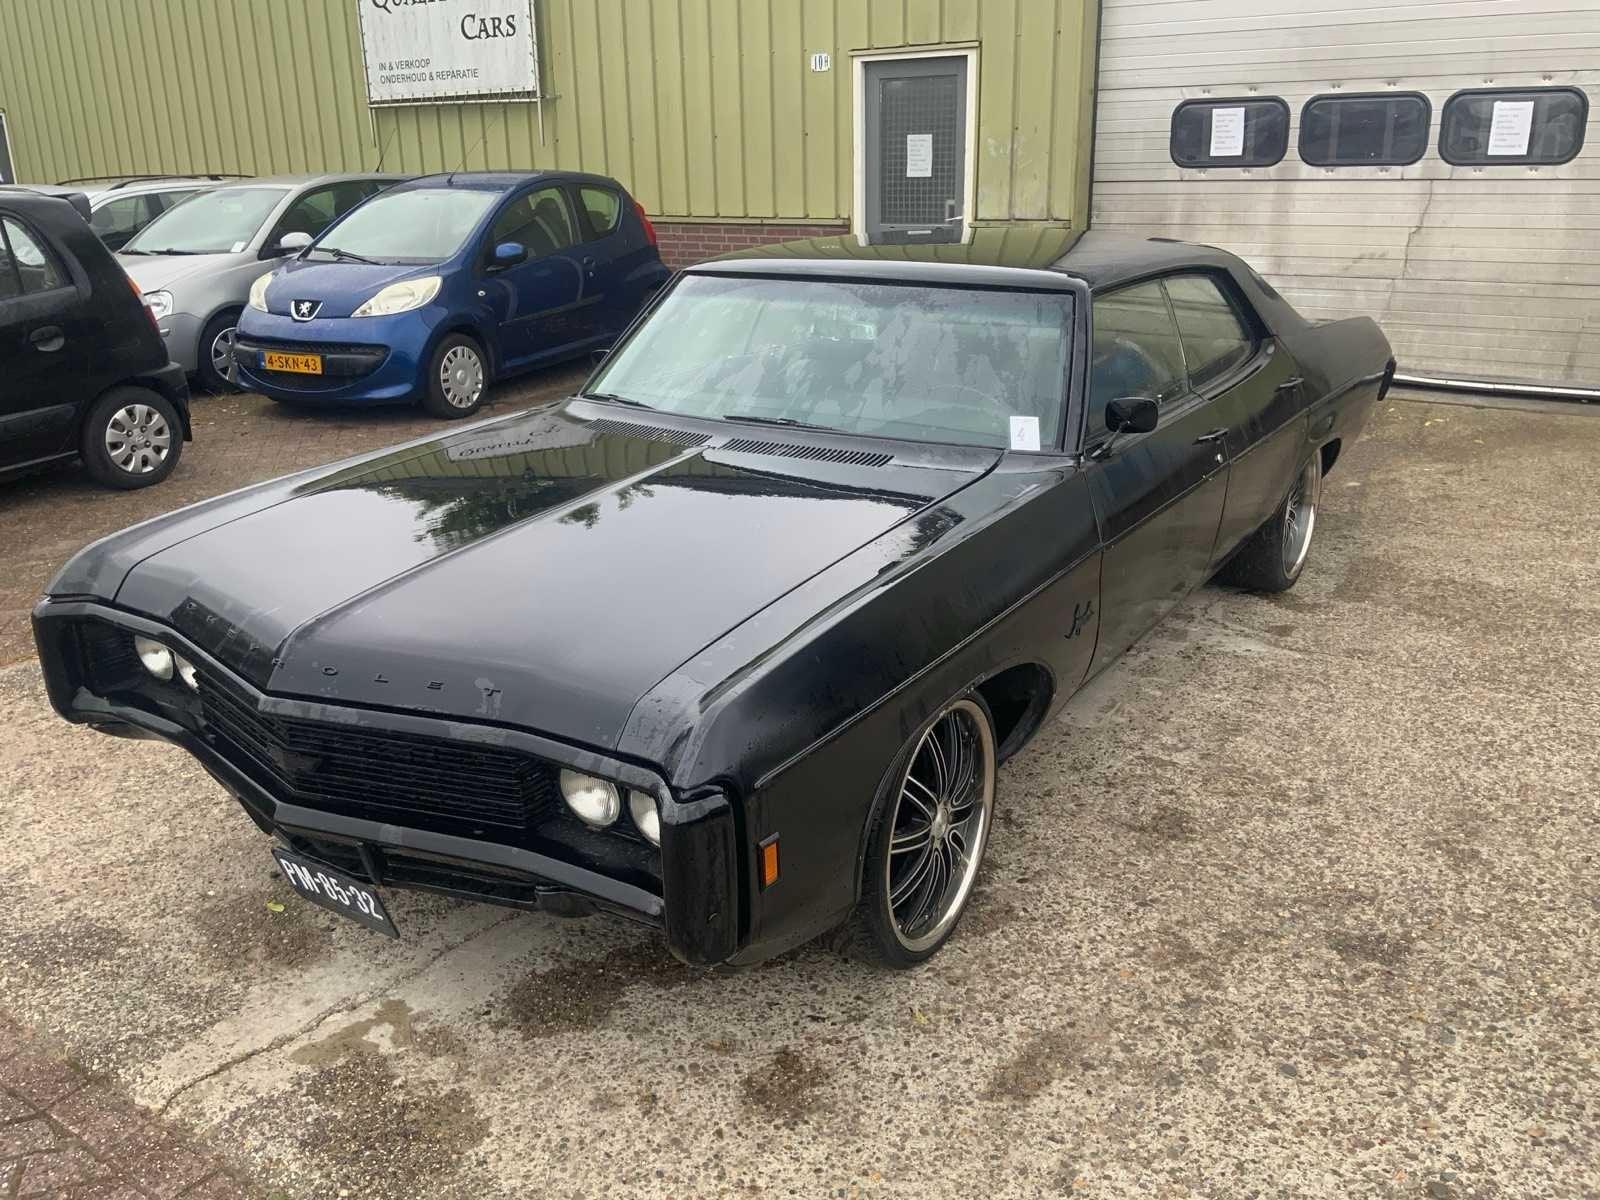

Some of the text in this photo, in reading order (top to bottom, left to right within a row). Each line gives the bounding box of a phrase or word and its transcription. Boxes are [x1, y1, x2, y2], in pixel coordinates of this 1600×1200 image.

[460, 14, 516, 40] CARS
[378, 58, 431, 71] IN & VERKOOP
[380, 68, 479, 85] ONDERHOUD & REPARATIE
[267, 353, 318, 371] 4-SKN-43
[279, 857, 384, 921] PM-85-32
